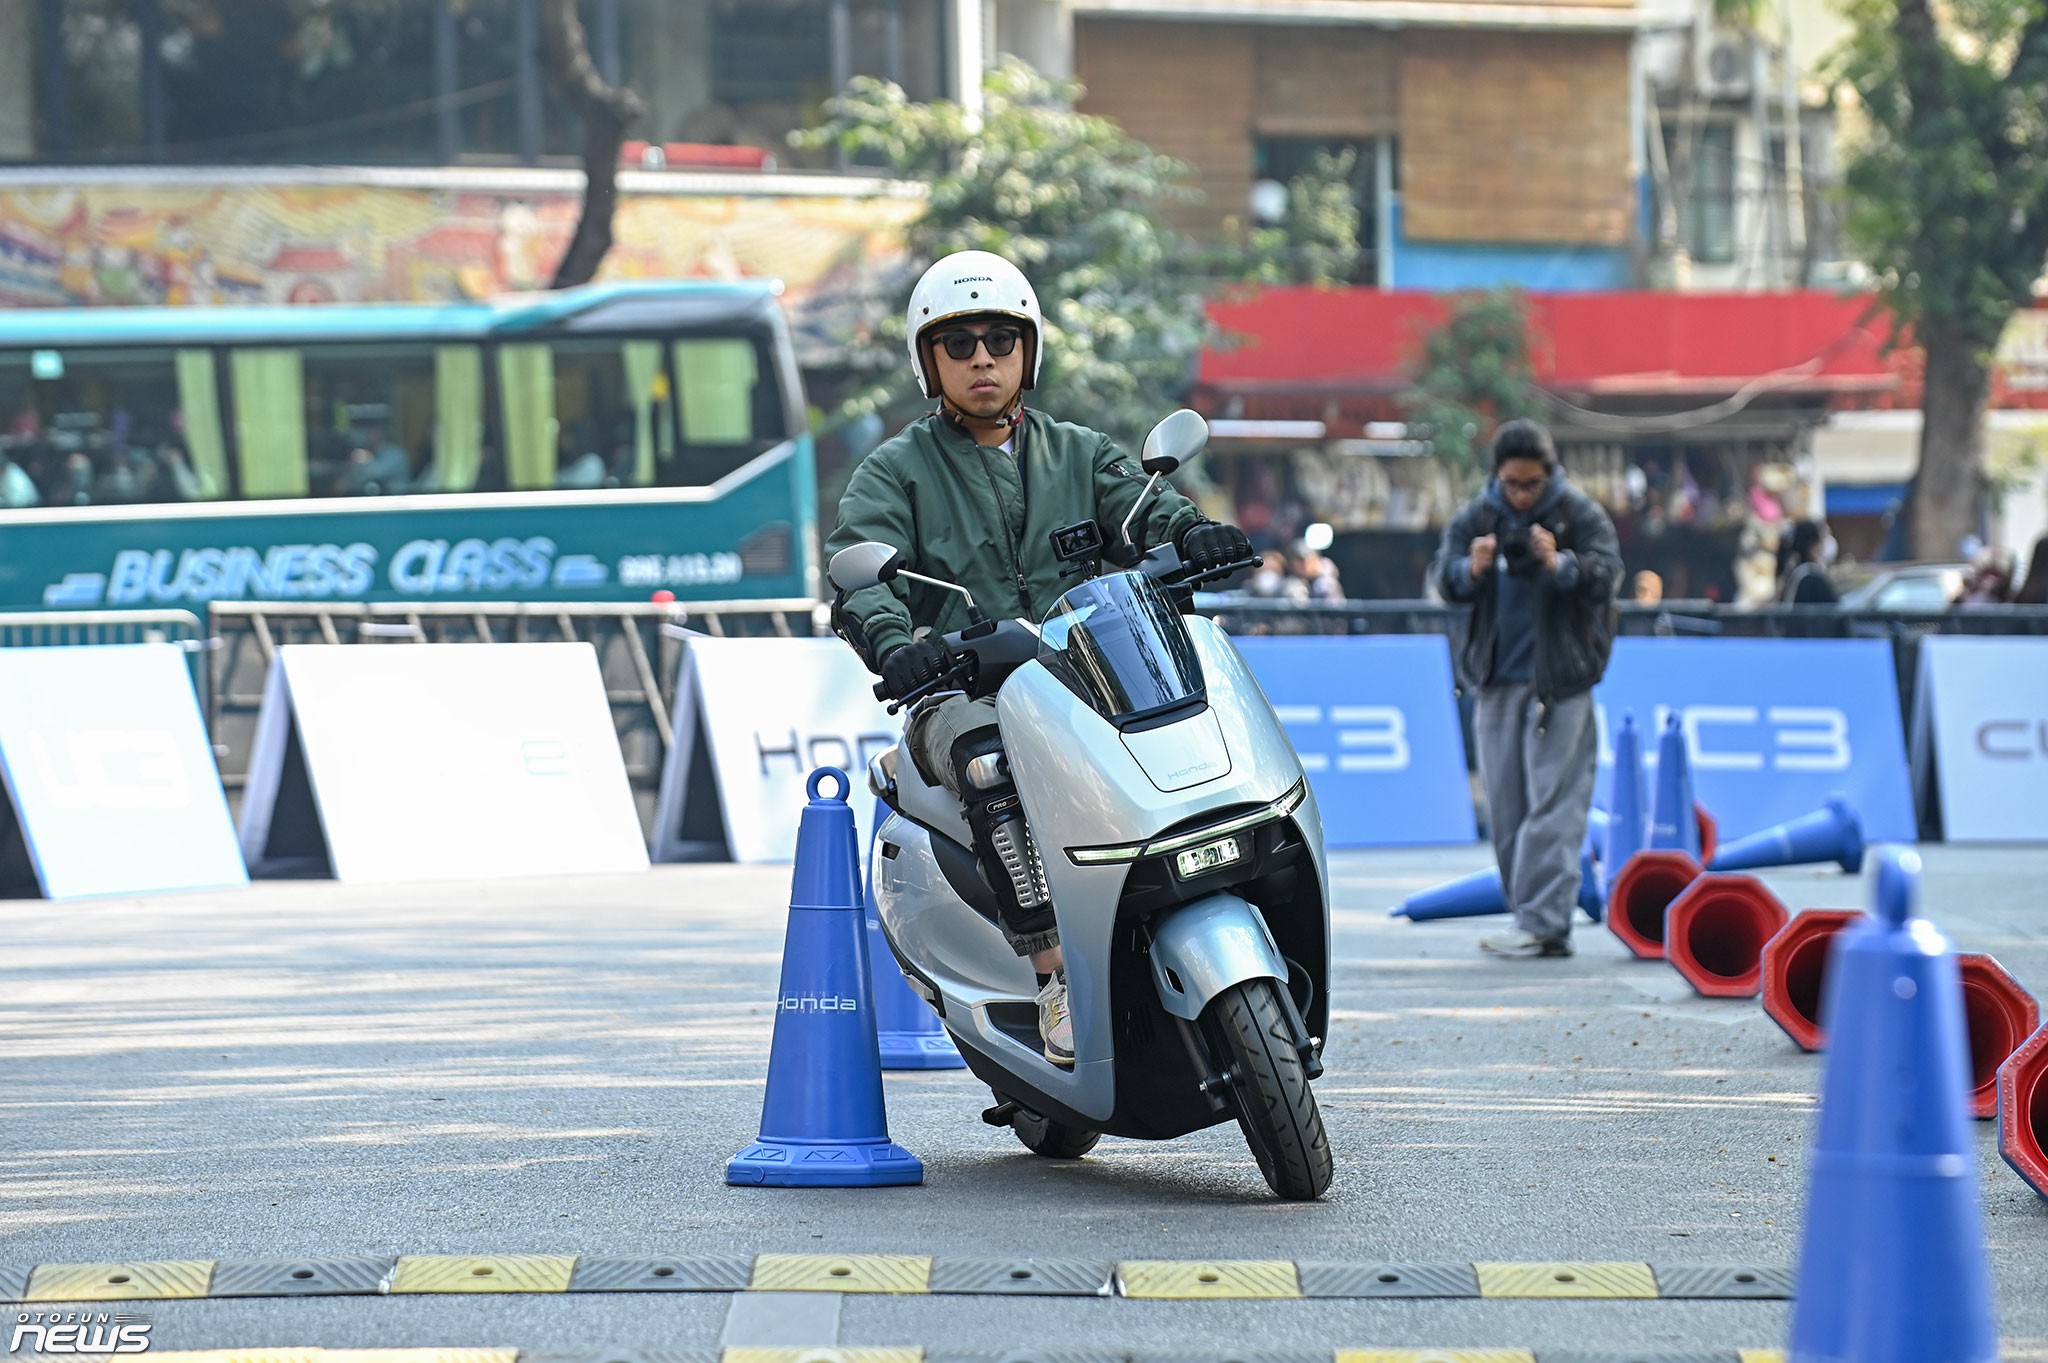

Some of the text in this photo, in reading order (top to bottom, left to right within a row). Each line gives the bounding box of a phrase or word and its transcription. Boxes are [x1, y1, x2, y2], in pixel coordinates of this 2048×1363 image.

[954, 276, 993, 285] HONDA
[107, 542, 379, 604] BUSINESS
[388, 536, 557, 595] CLASS
[754, 727, 898, 777] Hon
[1167, 761, 1217, 780] Honda
[777, 995, 857, 1011] Honda
